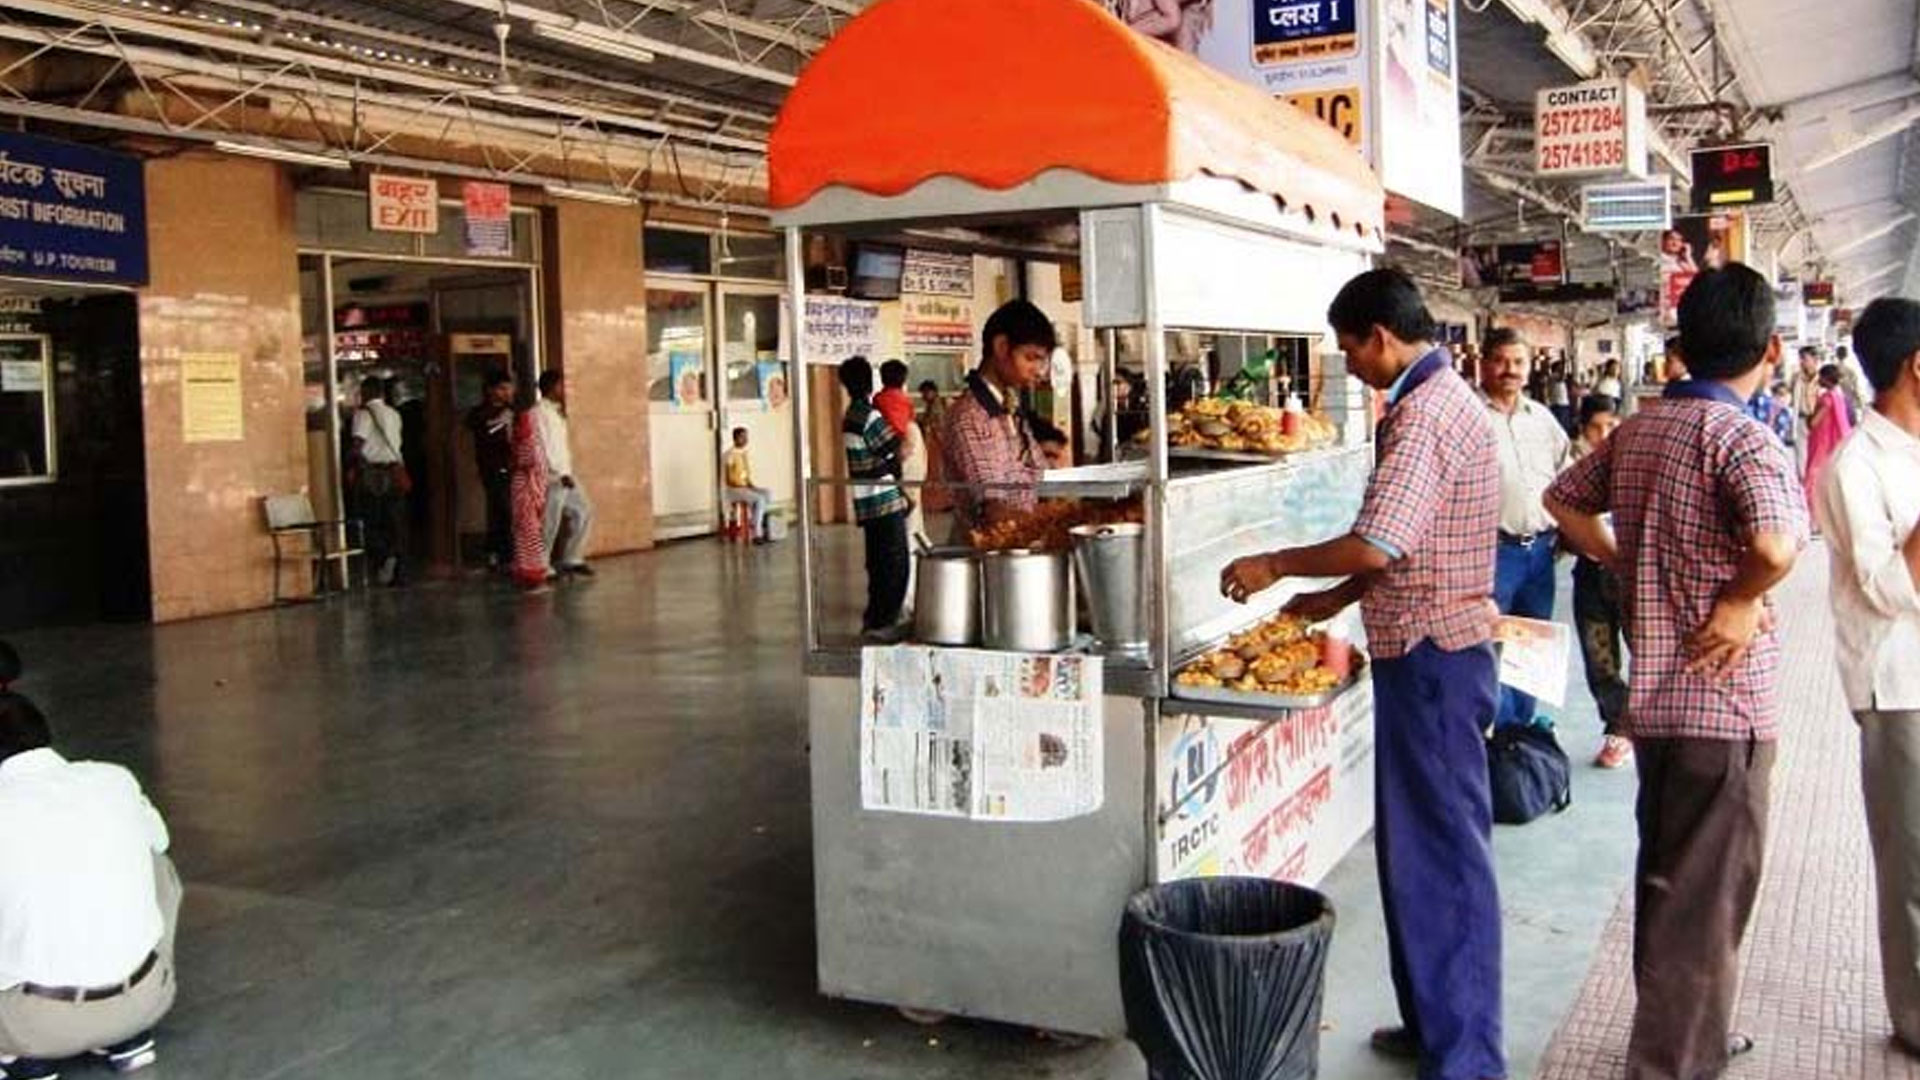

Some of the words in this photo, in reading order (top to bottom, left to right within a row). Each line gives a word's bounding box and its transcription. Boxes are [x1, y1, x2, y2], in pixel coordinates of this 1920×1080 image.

[1269, 3, 1321, 27] प्लस
[1548, 87, 1617, 106] CONTACT
[1541, 107, 1623, 137] 25727284
[1541, 141, 1623, 170] 25741836
[51, 169, 106, 199] सूचना
[33, 202, 125, 233] INFORMATION
[380, 204, 428, 229] EXIT
[1170, 813, 1219, 869] IRCTC
